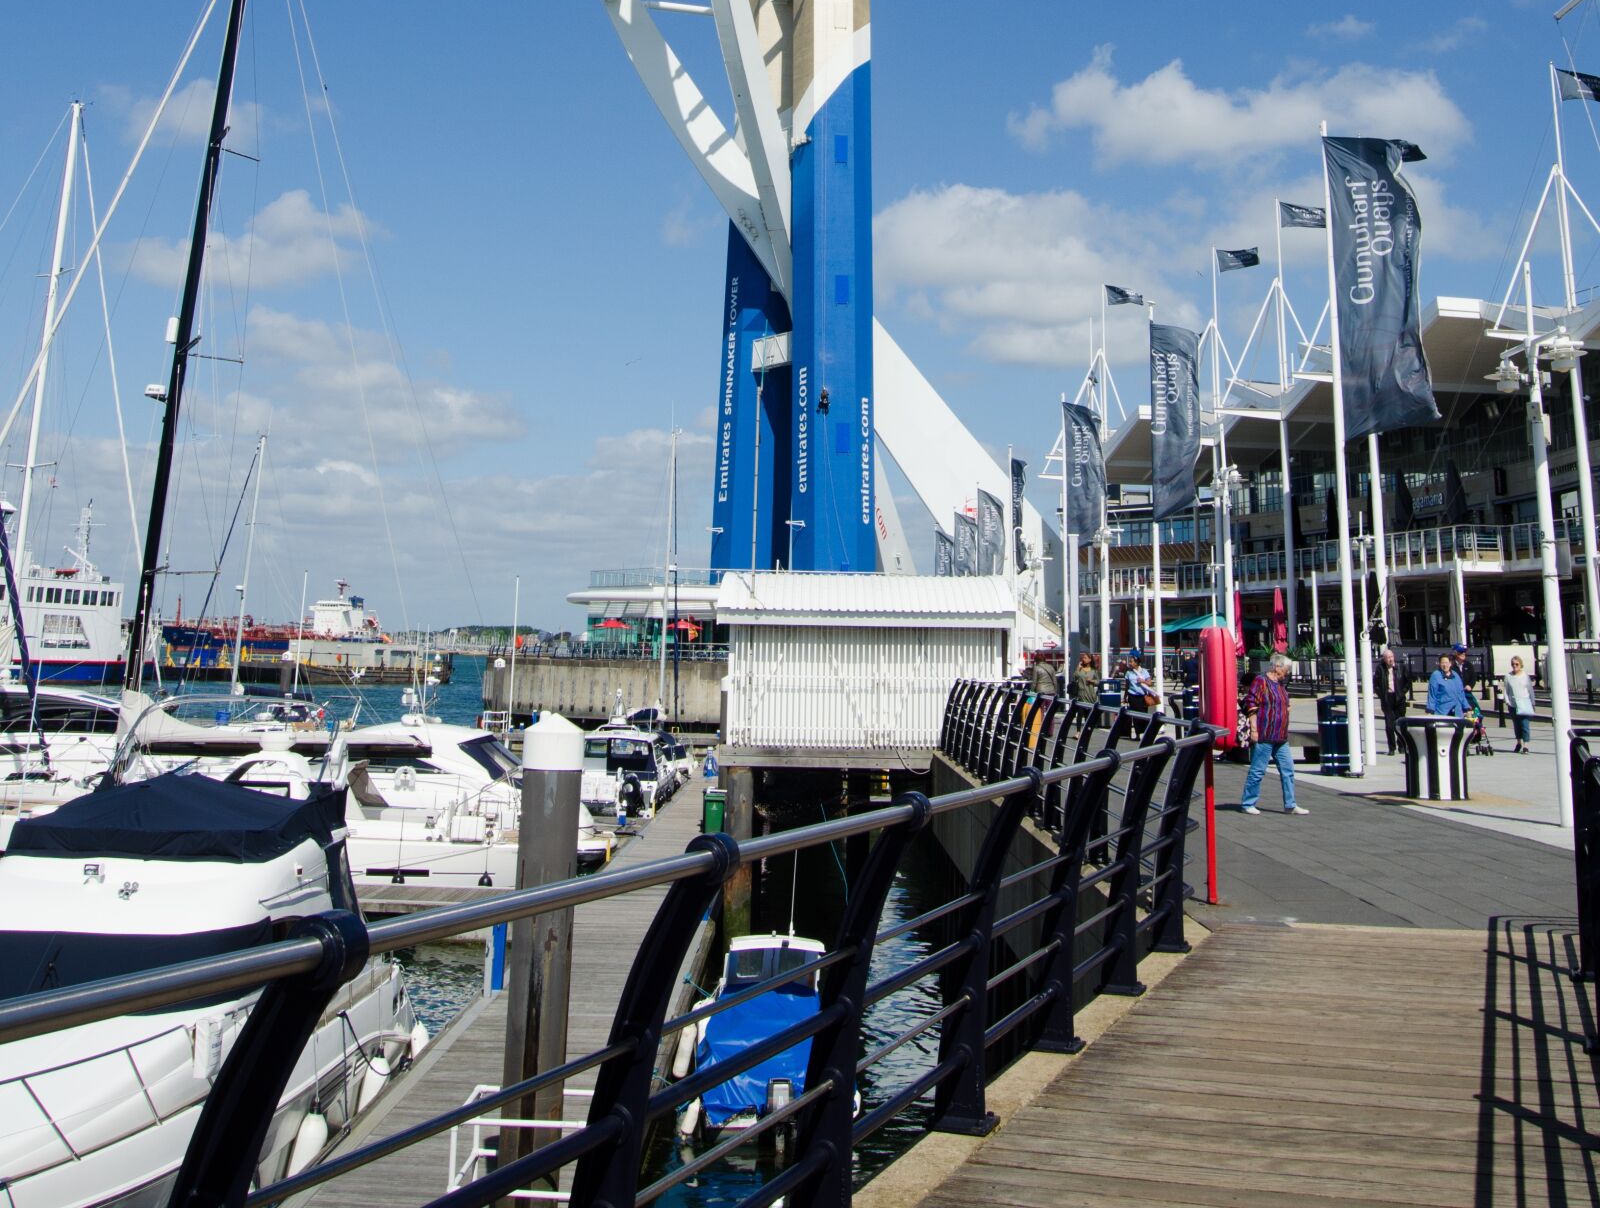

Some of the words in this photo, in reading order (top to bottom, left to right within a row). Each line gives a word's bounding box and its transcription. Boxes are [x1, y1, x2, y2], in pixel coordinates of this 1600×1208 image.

[1345, 176, 1375, 305] Gunwharf
[1371, 179, 1394, 256] Quays
[729, 276, 739, 328] TOWER
[724, 332, 736, 415] SPINNAKER
[1150, 349, 1168, 435] Gunwharf
[1166, 352, 1181, 404] Quays
[718, 421, 731, 503] Emirates
[798, 366, 807, 494] emirates.com
[861, 397, 869, 525] emirates.com
[1071, 422, 1083, 487] Gunwharf
[1080, 425, 1092, 464] Quays
[1411, 492, 1443, 511] agamama
